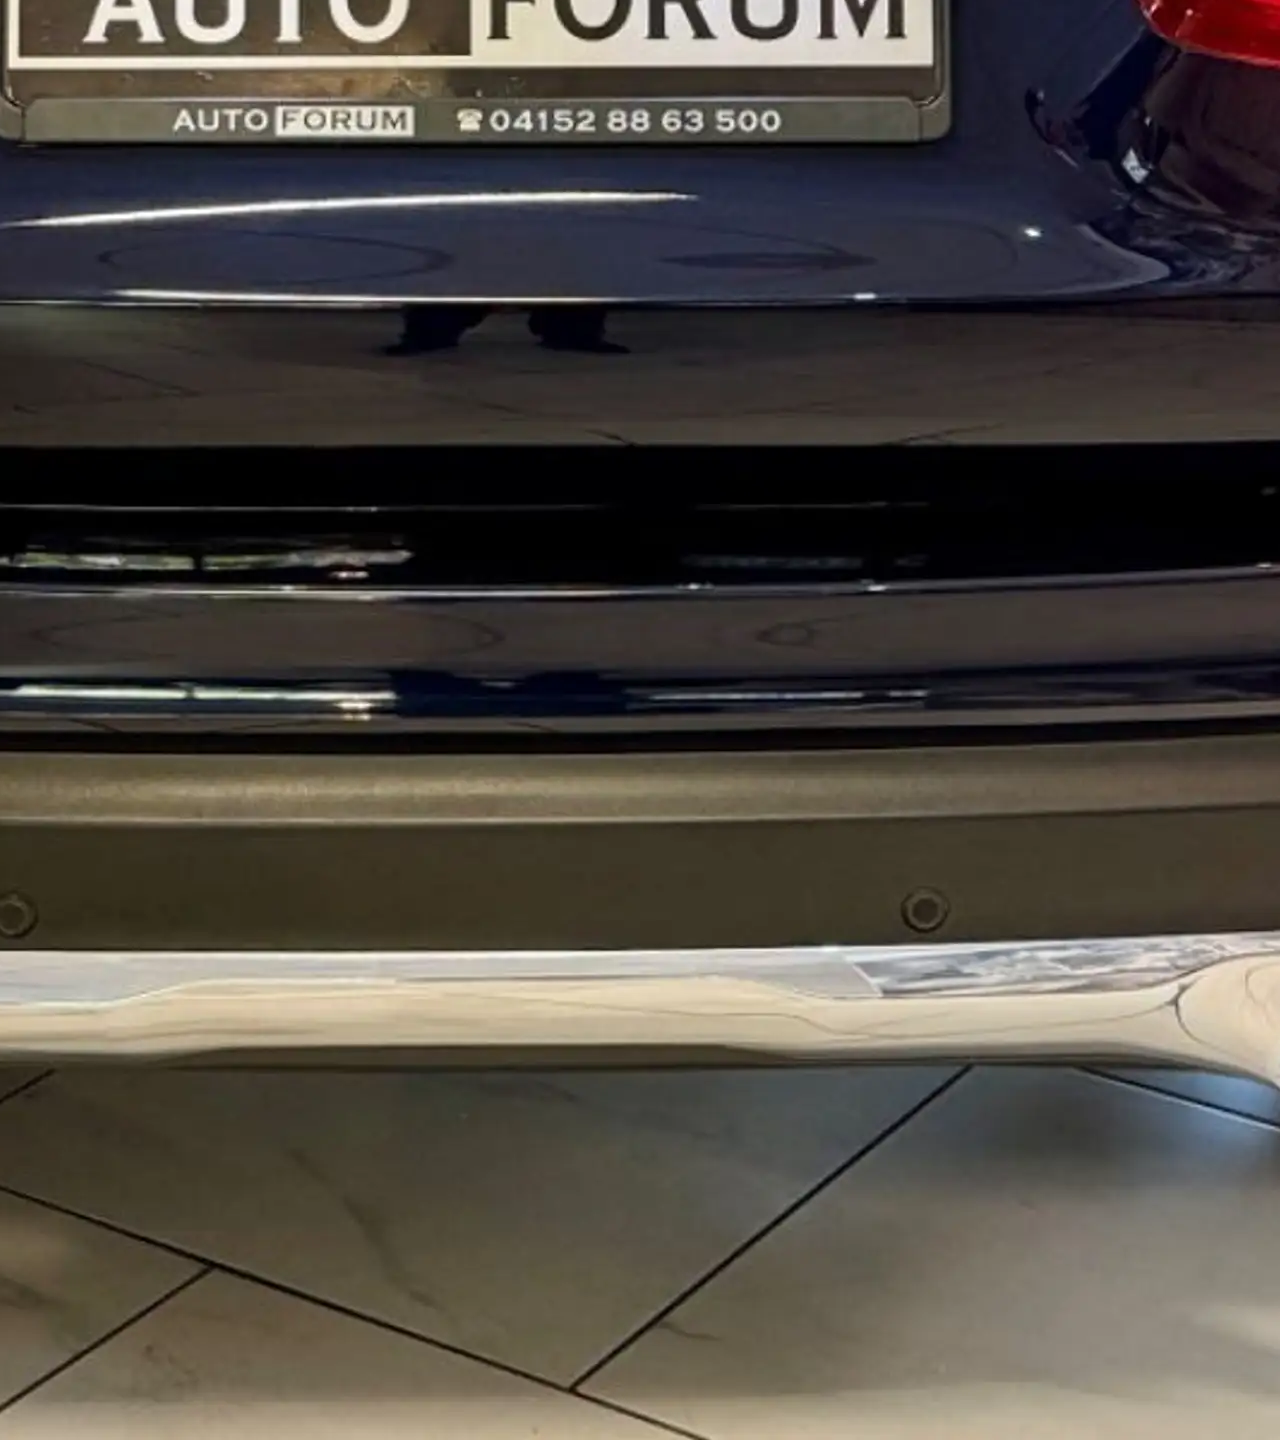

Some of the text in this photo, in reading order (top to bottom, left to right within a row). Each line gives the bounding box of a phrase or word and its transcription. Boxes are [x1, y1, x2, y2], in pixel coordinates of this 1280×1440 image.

[173, 108, 407, 132] AUTO FORUM
[488, 109, 782, 133] 04152 88 63 500
